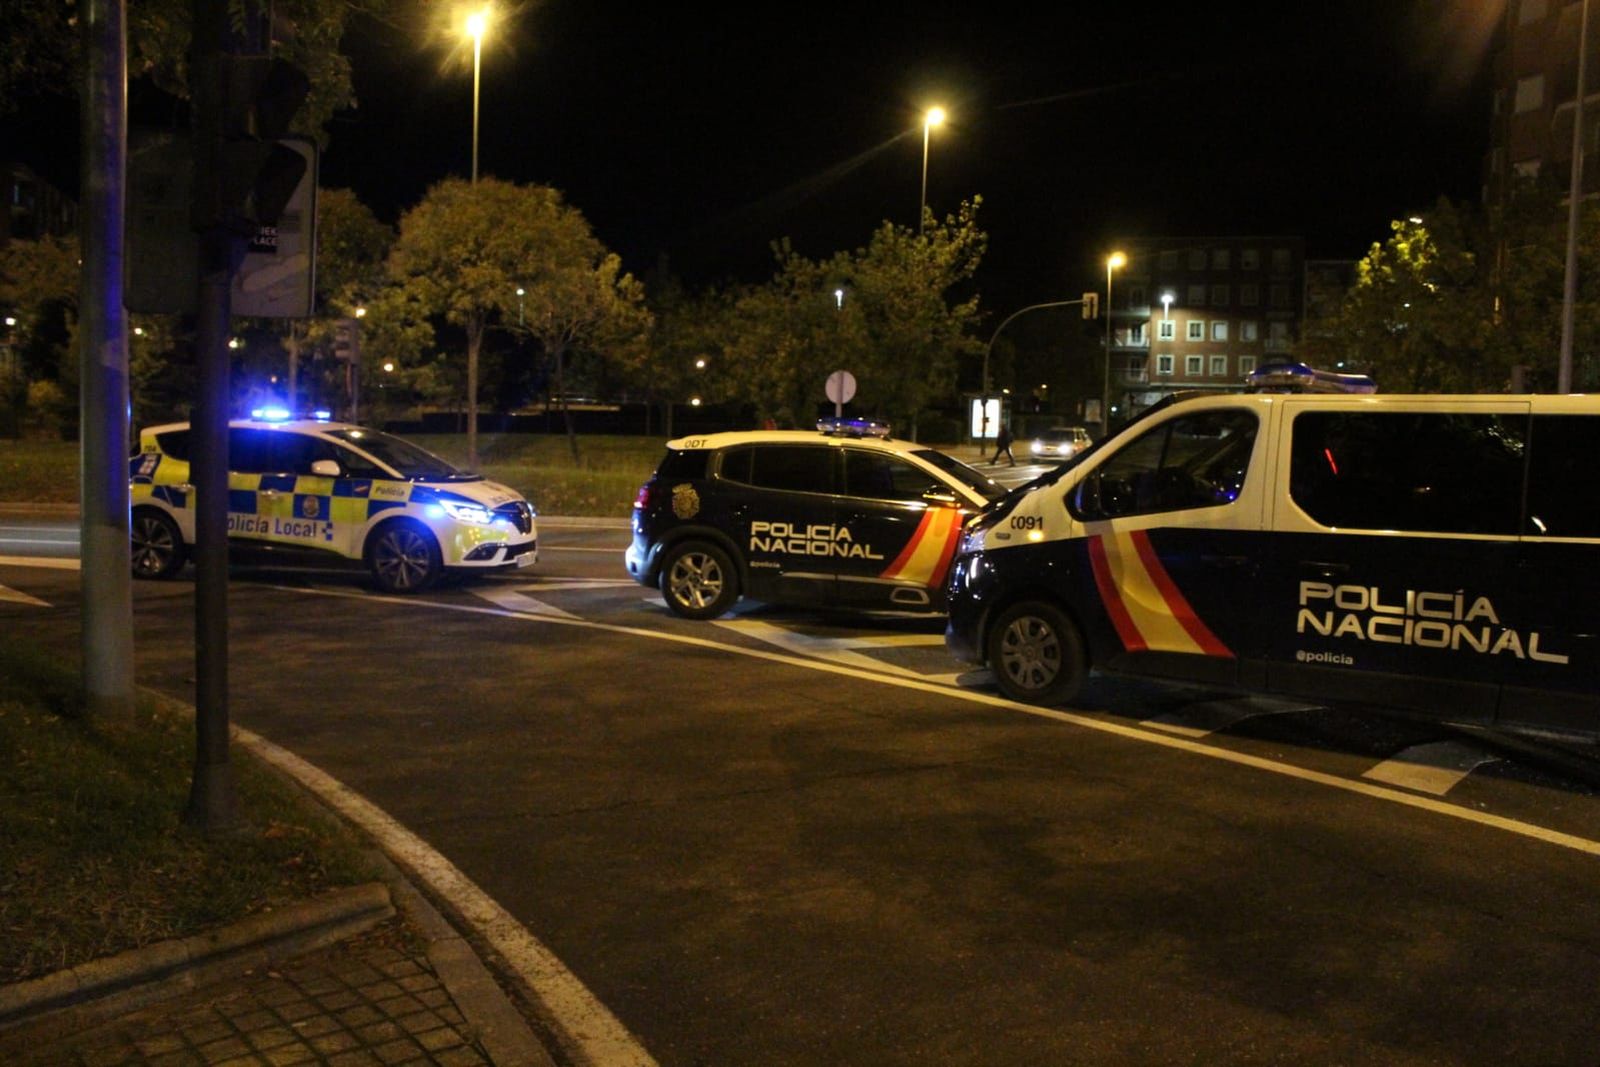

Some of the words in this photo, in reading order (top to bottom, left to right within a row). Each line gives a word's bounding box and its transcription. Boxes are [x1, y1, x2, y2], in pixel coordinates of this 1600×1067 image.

[227, 515, 269, 533] olicía
[274, 518, 317, 537] Local
[751, 520, 853, 543] POLICÍA
[750, 536, 885, 560] NACIONAL
[1299, 580, 1501, 625] POLICÍA
[1296, 608, 1570, 665] NACIONAL
[1296, 649, 1354, 666] @policia
